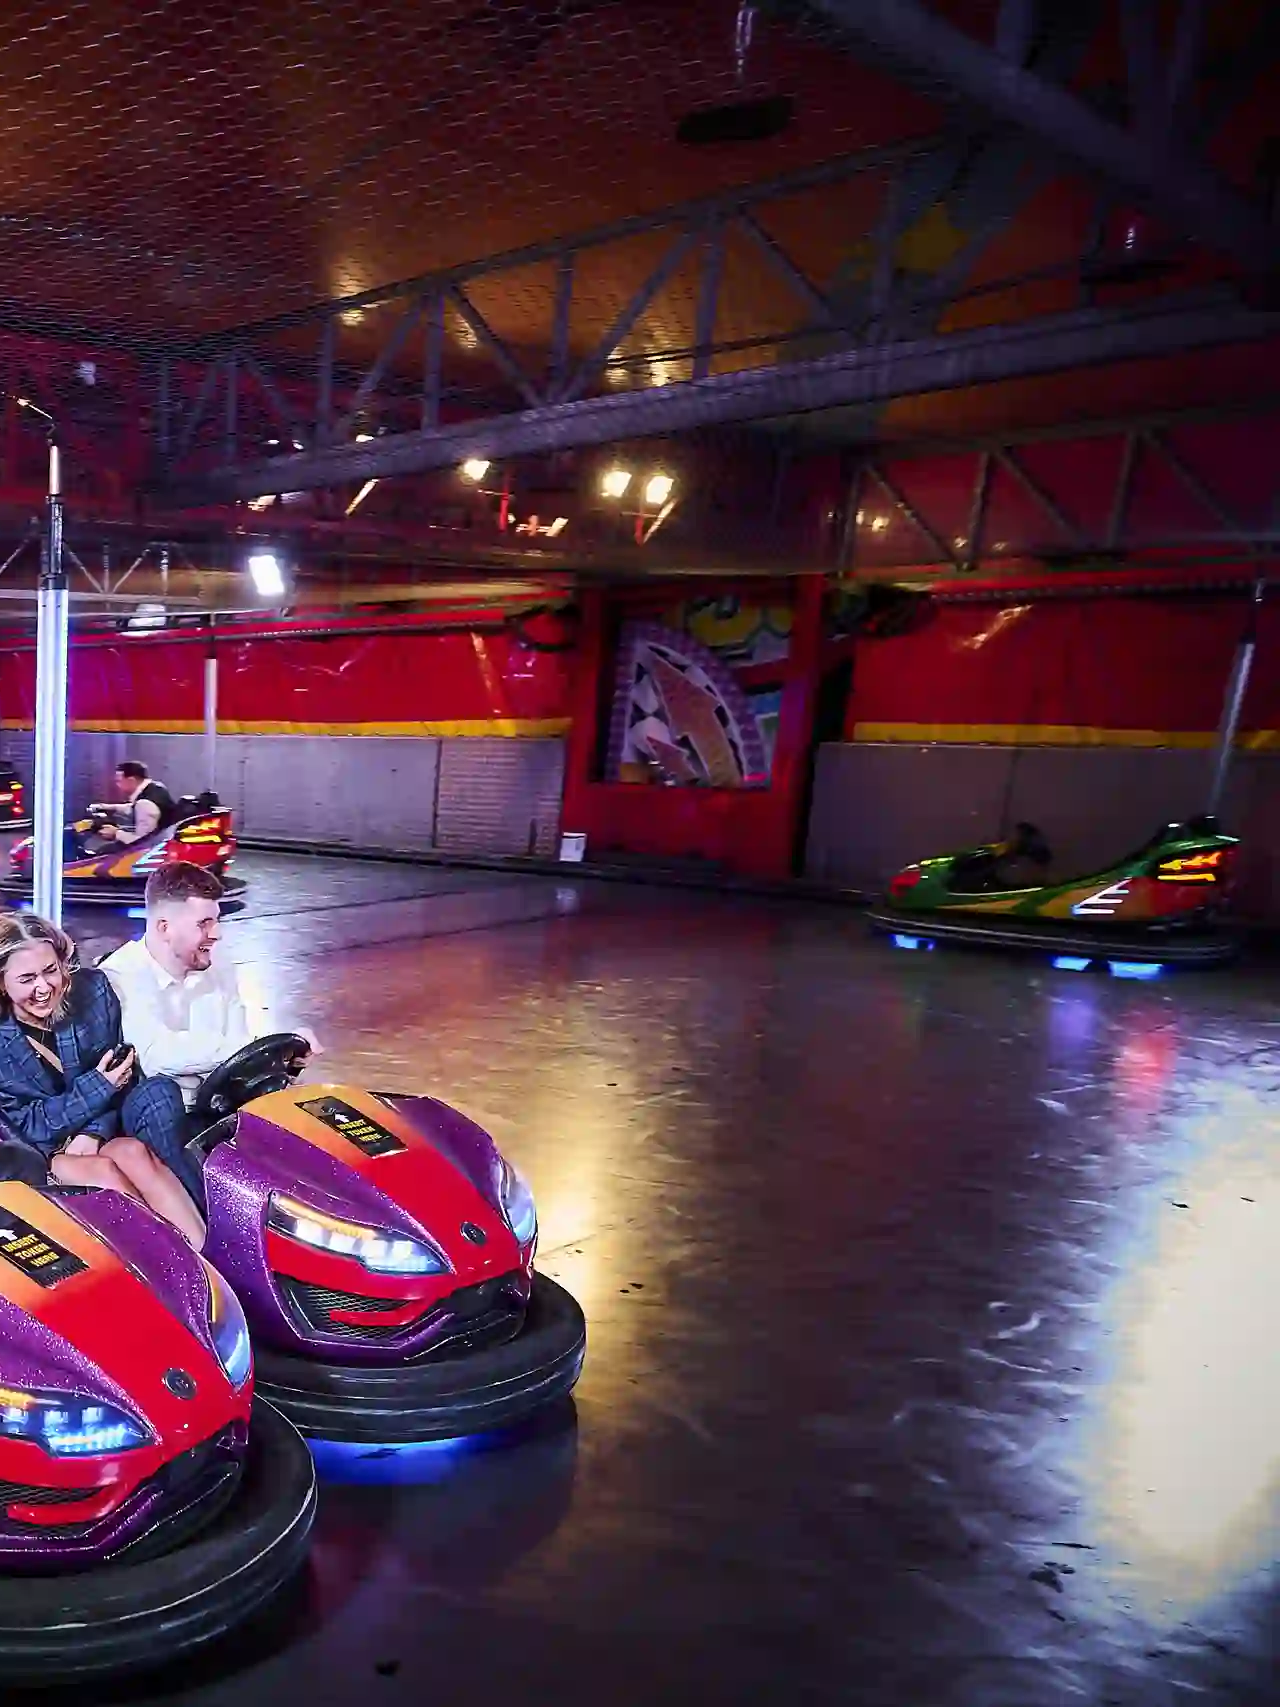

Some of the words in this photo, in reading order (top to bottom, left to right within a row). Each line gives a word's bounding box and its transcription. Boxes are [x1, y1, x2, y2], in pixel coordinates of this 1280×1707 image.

[1, 1234, 39, 1252] INSERT
[14, 1243, 51, 1260] TOKEN
[30, 1252, 60, 1267] HERE
